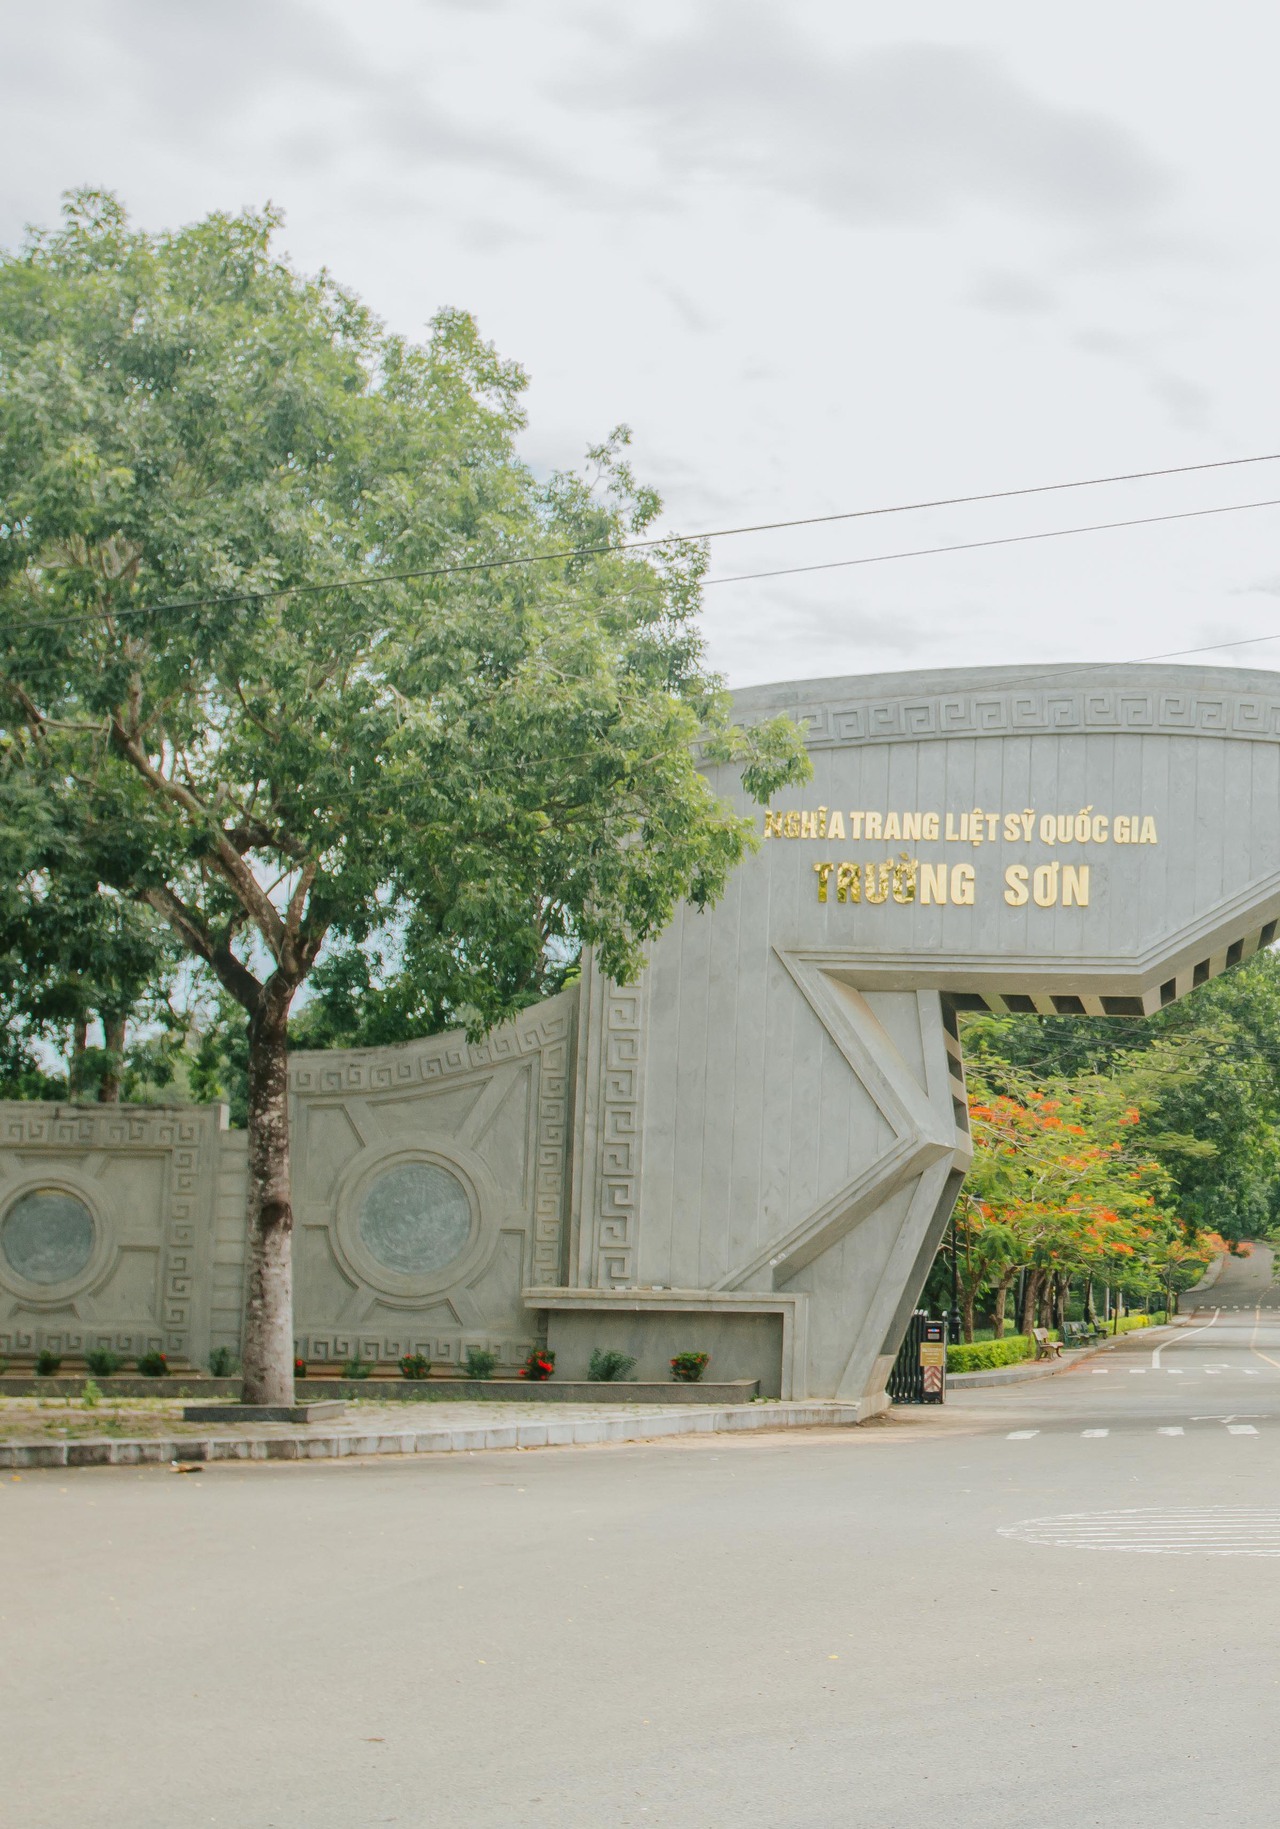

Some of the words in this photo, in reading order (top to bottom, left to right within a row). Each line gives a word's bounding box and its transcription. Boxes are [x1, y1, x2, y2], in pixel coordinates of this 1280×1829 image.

[764, 806, 845, 840] NGHĨA
[850, 811, 939, 841] TRANG
[945, 808, 1000, 846] LIỆT
[1003, 808, 1036, 842] SỸ
[1039, 805, 1108, 846] QUỐC
[1113, 815, 1158, 844] GIA
[813, 852, 975, 905] TRƯỜNG
[1003, 861, 1090, 907] SƠN
